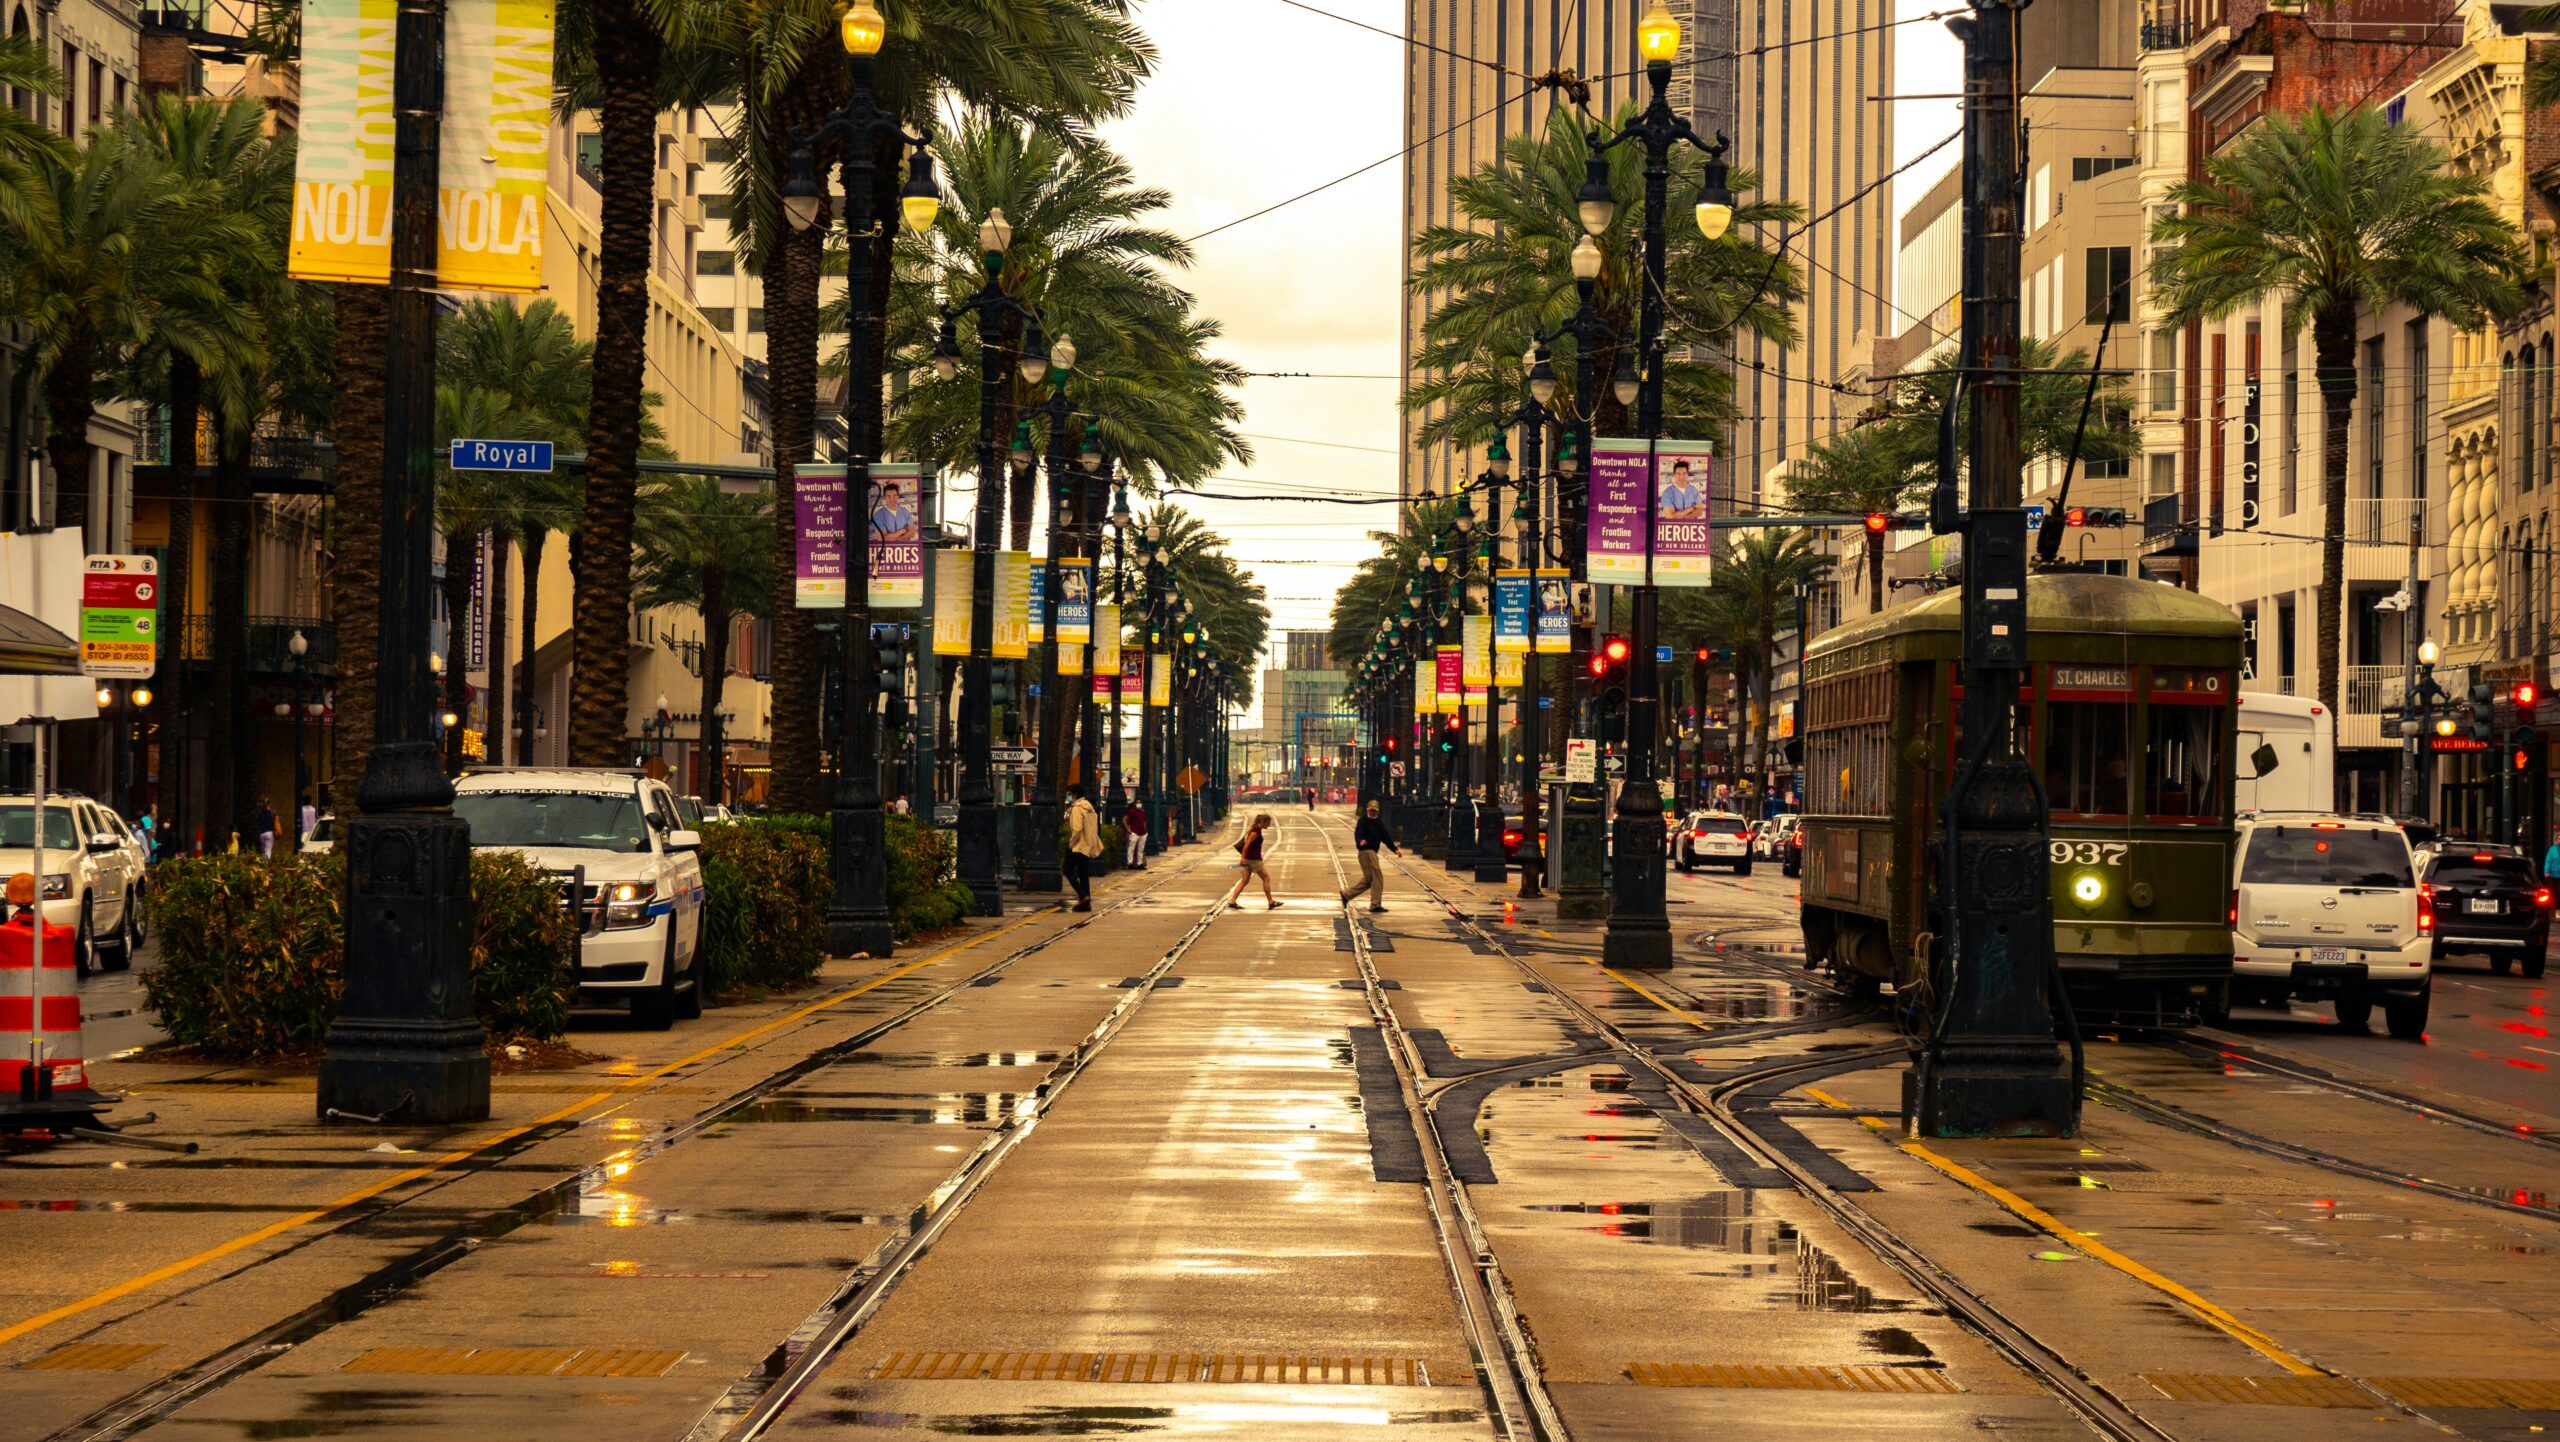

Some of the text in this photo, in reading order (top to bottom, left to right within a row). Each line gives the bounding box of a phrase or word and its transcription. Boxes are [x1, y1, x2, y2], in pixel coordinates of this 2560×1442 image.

[296, 16, 358, 184] DOWN
[487, 25, 554, 190] TOWN
[295, 181, 393, 246] NOL
[475, 442, 536, 469] Royal
[2243, 385, 2260, 522] FOGO
[1593, 457, 1647, 467] Downtown NOLA
[1599, 469, 1627, 477] thanks
[796, 482, 847, 492] Downtown NOL
[1607, 479, 1620, 488] all
[1610, 491, 1627, 500] First
[813, 504, 826, 512] all
[1598, 504, 1637, 514] Responders
[816, 516, 833, 525] First
[1608, 516, 1625, 524] and
[805, 528, 844, 539] Responders
[1602, 527, 1632, 537] Frontline
[1657, 525, 1706, 542] HEROES
[816, 541, 833, 549] and
[1602, 540, 1631, 550] Workers
[810, 552, 840, 561] Frontline
[869, 546, 919, 564] HEROES
[90, 560, 110, 569] RTA
[811, 564, 840, 574] Workers
[475, 557, 483, 597] GIFTS
[137, 587, 151, 597] 47
[1057, 606, 1088, 617] HEROES
[136, 620, 150, 630] 48
[1538, 617, 1568, 628] HEROES
[474, 606, 483, 664] LUGGAGE
[88, 651, 149, 661] STOP ID #5533
[2057, 670, 2126, 686] ST. CHARLES
[576, 789, 631, 799] POLICE
[2050, 841, 2128, 866] 937
[2317, 951, 2345, 961] ZFE223
